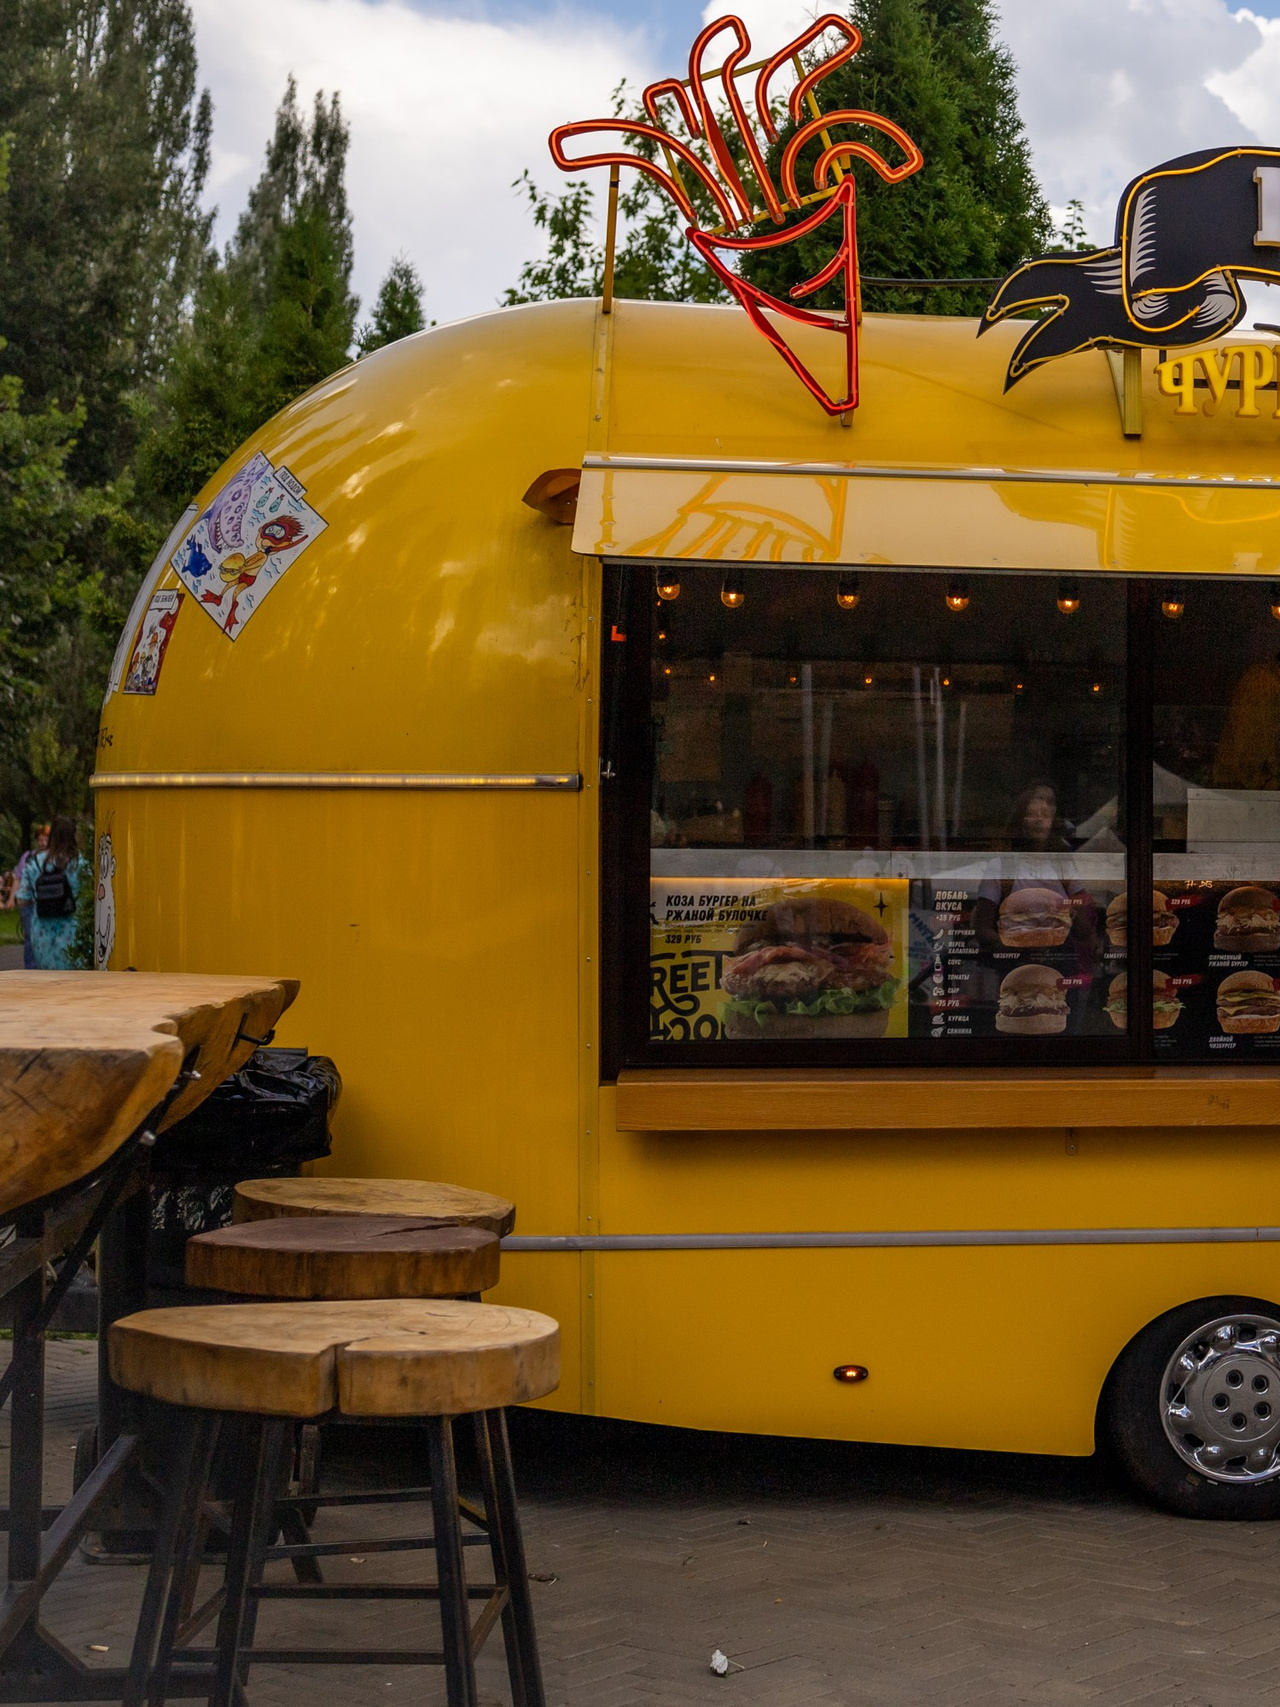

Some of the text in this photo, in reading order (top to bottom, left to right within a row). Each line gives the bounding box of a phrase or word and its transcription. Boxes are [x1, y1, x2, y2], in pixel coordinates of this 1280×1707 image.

[666, 895, 756, 907] КОЗА БУРГЕР НА
[935, 891, 969, 901] ДОБАВЬ
[935, 901, 962, 911] ВКУСА
[666, 907, 768, 921] РЖАНОЙ БУЛОЧКЕ
[665, 934, 702, 944] 329 РУБ
